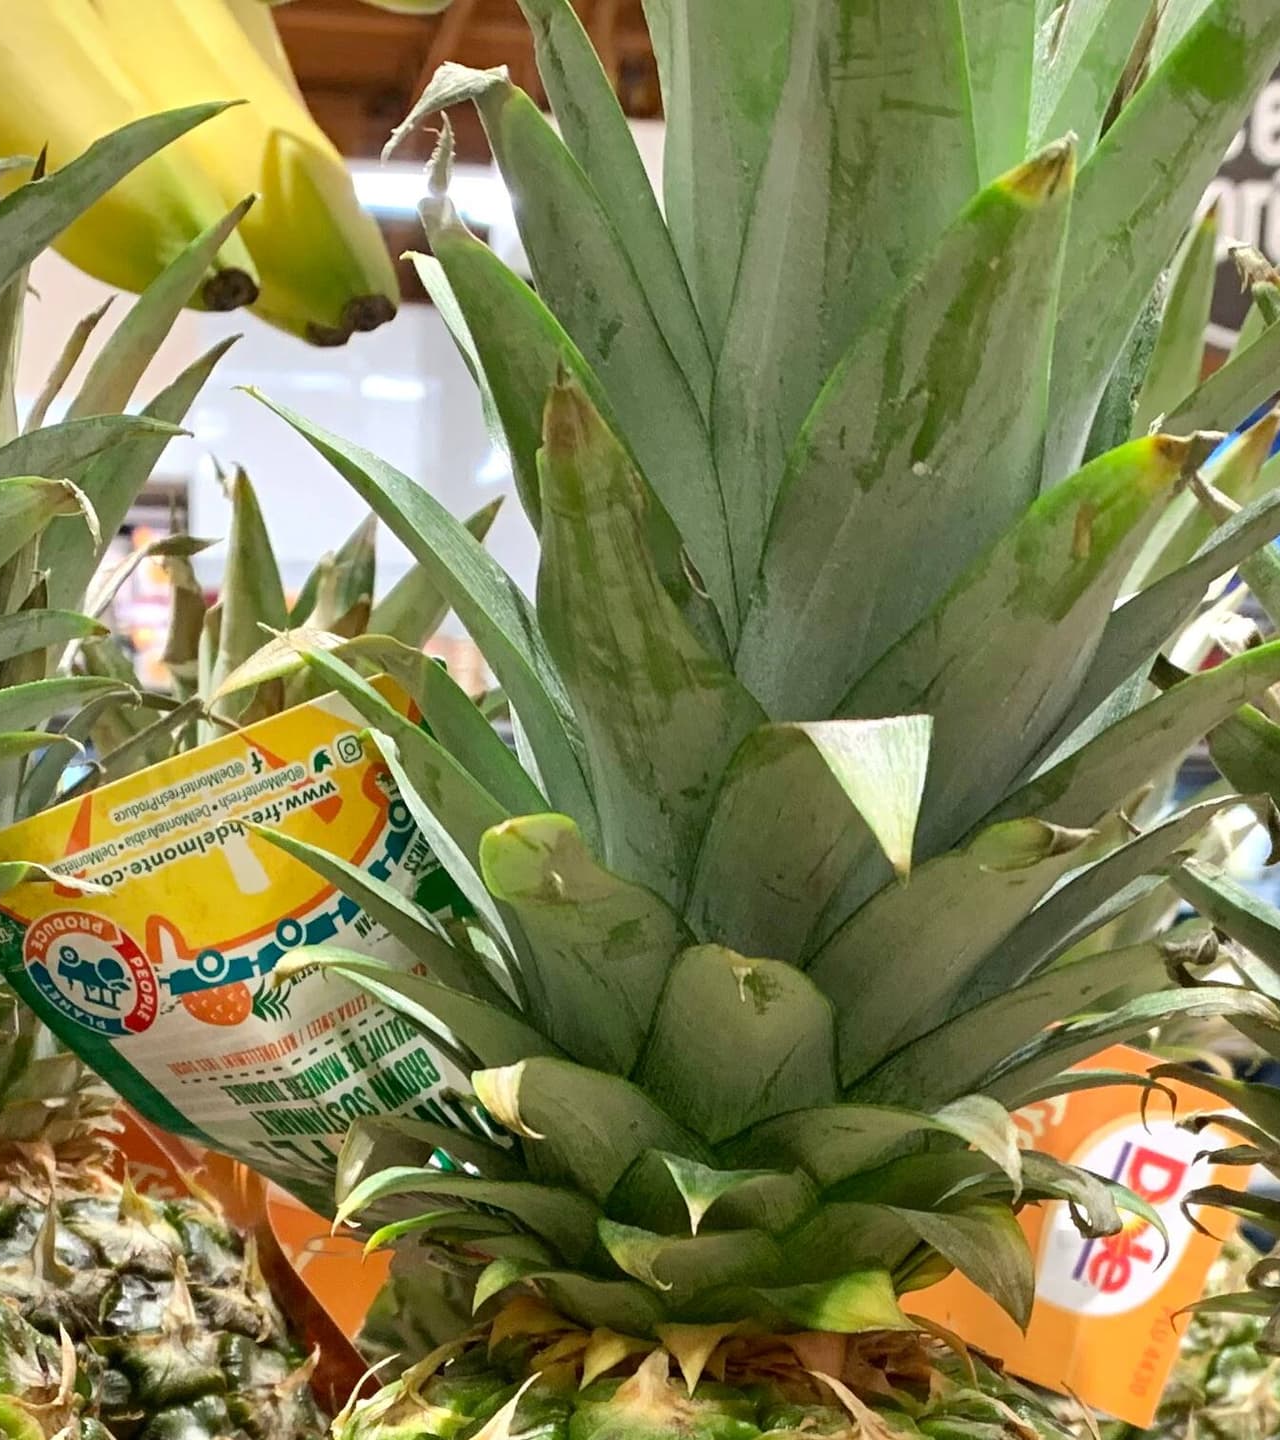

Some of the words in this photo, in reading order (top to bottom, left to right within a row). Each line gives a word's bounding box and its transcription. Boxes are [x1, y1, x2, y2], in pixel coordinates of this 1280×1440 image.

[114, 762, 245, 821] @DelMonteFreshProduce
[223, 764, 305, 811] @DelMonteFresh
[125, 802, 213, 846] DelMonteArabia
[31, 915, 103, 950] PRODUCE
[41, 978, 106, 1030] PLANET
[130, 956, 154, 1021] PEOPLE
[341, 1041, 368, 1074] DE
[367, 1047, 441, 1112] GROWN
[249, 1086, 379, 1136] SUSTAINABLY
